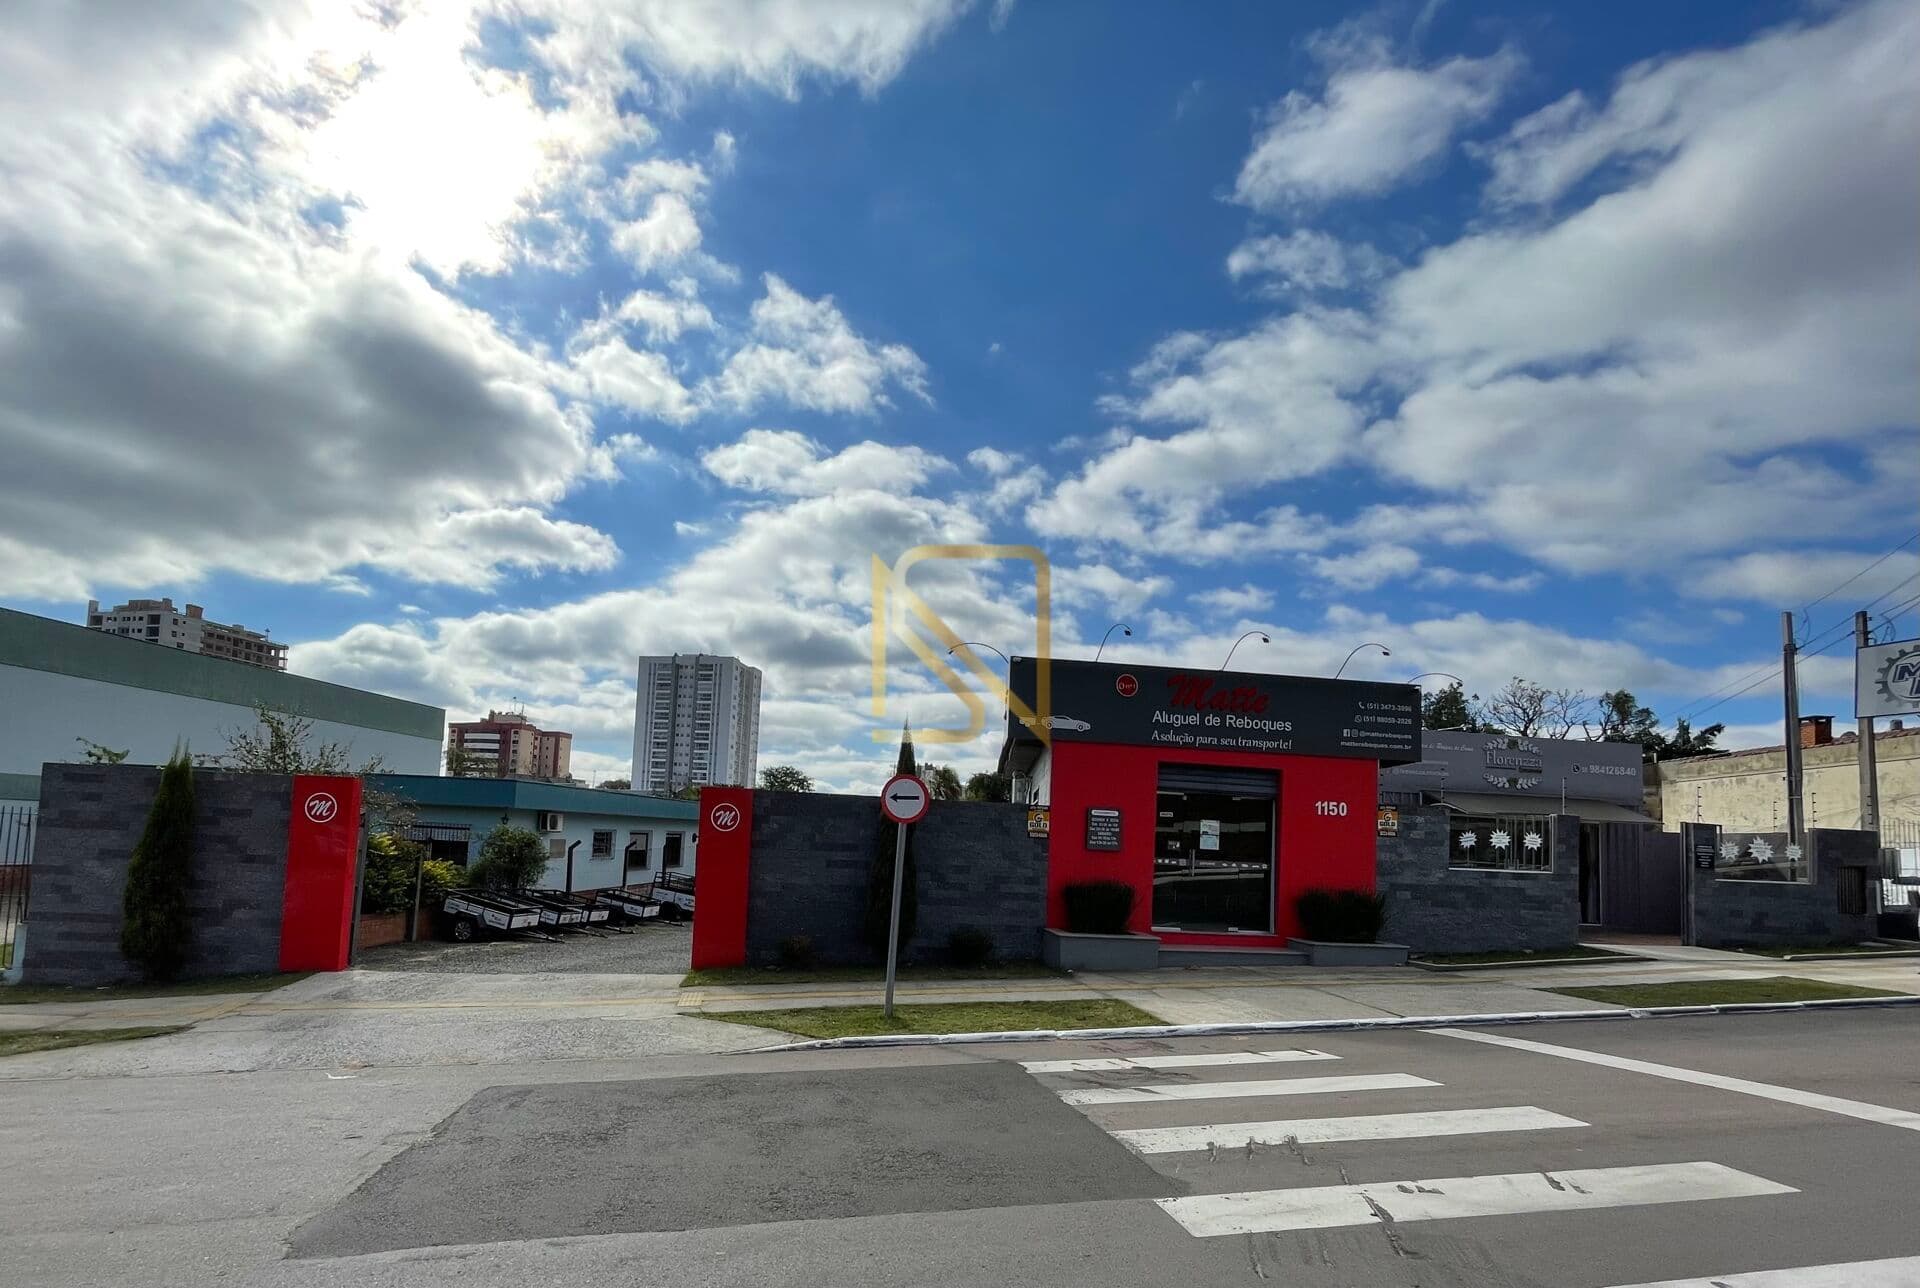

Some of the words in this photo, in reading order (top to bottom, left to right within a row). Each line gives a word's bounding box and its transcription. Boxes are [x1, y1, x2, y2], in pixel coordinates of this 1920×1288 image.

[1167, 673, 1271, 714] Matte
[1152, 710, 1200, 728] Aluguel
[1204, 714, 1221, 727] de
[1225, 714, 1293, 733] Reboques
[1151, 730, 1160, 741] A
[1160, 730, 1195, 746] solução
[1195, 736, 1218, 747] para
[1220, 738, 1237, 747] seu
[1238, 737, 1293, 751] transporte!
[1485, 750, 1543, 768] Florenzza
[1315, 801, 1348, 817] 1150
